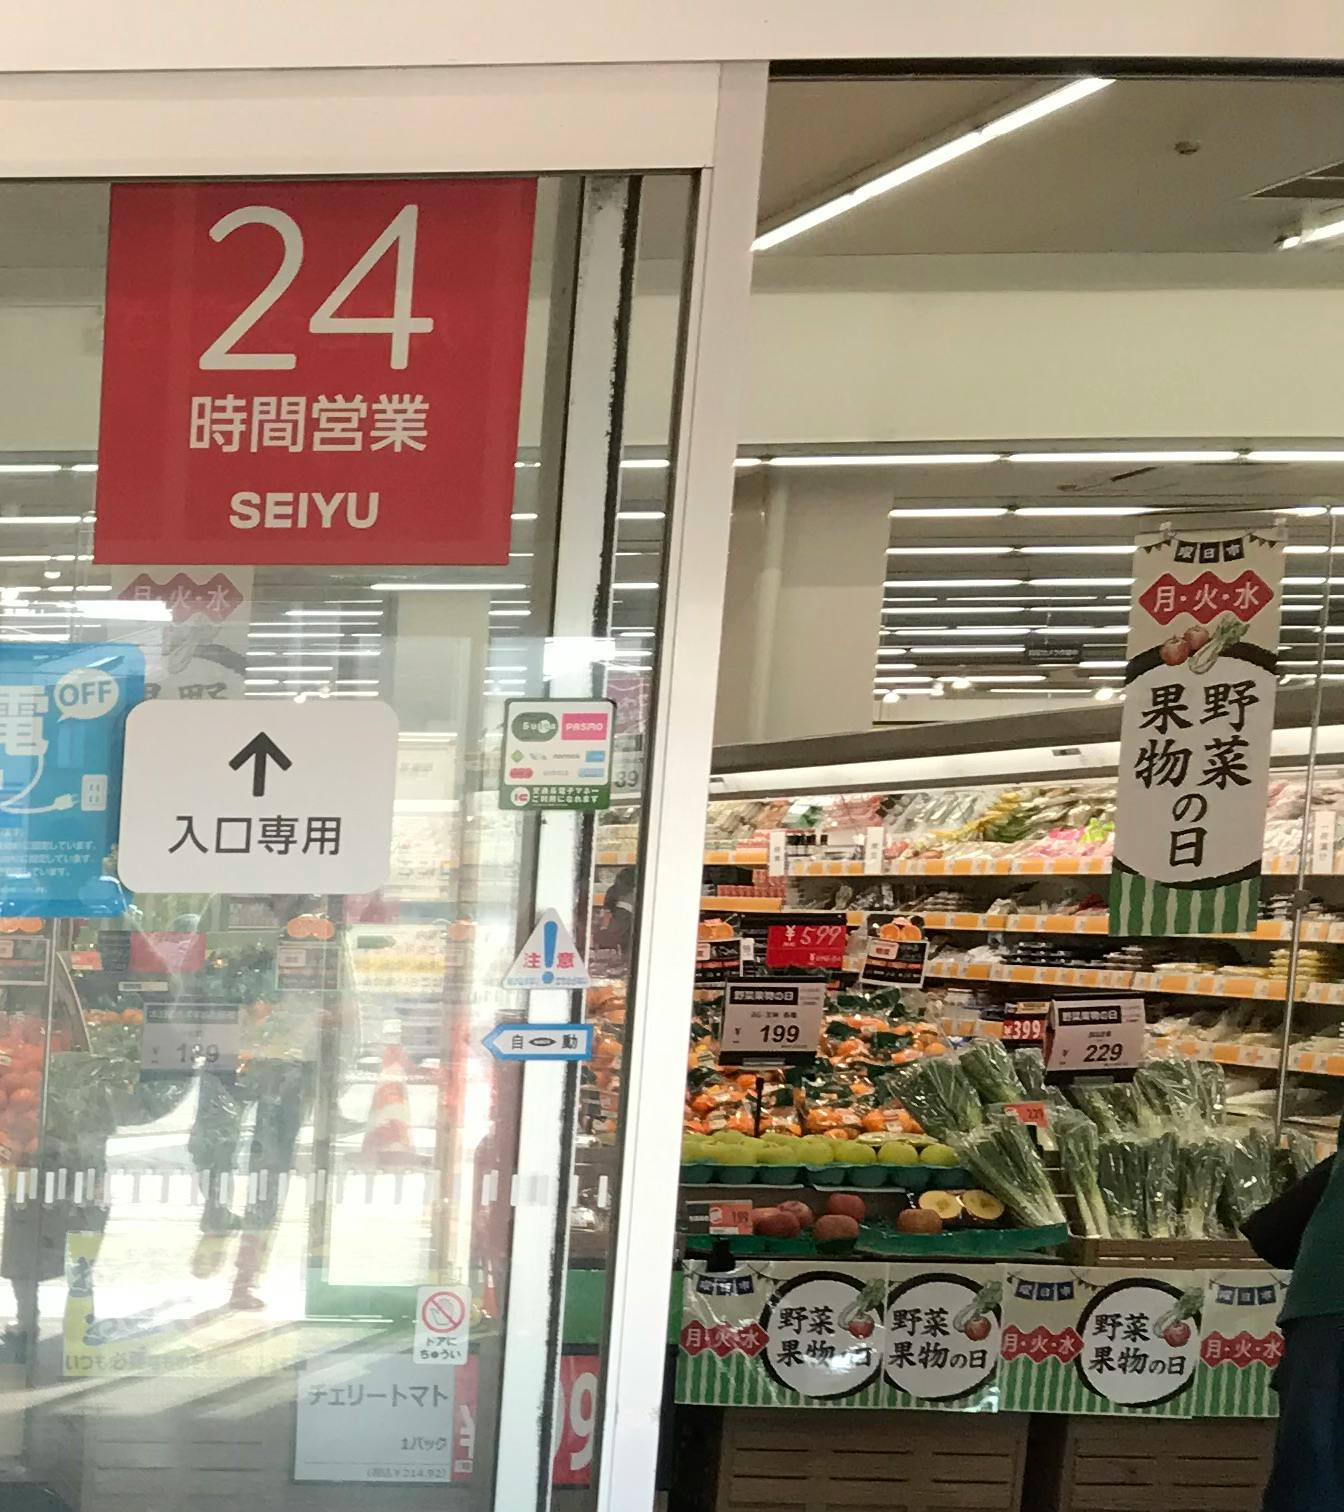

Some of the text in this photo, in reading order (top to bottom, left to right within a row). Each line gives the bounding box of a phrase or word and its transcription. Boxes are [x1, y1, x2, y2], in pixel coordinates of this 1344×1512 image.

[198, 204, 433, 372] 24
[188, 395, 430, 452] 時間営業
[228, 491, 380, 530] SEIYU
[1153, 584, 1260, 612] 月・火・水
[59, 680, 112, 706] OFF
[566, 722, 603, 731] PASMO
[168, 814, 343, 857] 入口専用
[523, 952, 575, 968] 注意
[512, 1035, 577, 1049] 自動
[761, 1024, 800, 1043] 199
[1083, 1044, 1123, 1062] 229
[778, 1306, 836, 1336] 野菜
[891, 1307, 950, 1338] 野菜
[1093, 1312, 1151, 1342] 野菜
[889, 1342, 987, 1369] 果物の日
[1089, 1347, 1186, 1375] 果物の日
[309, 1384, 449, 1407] チェリートマト
